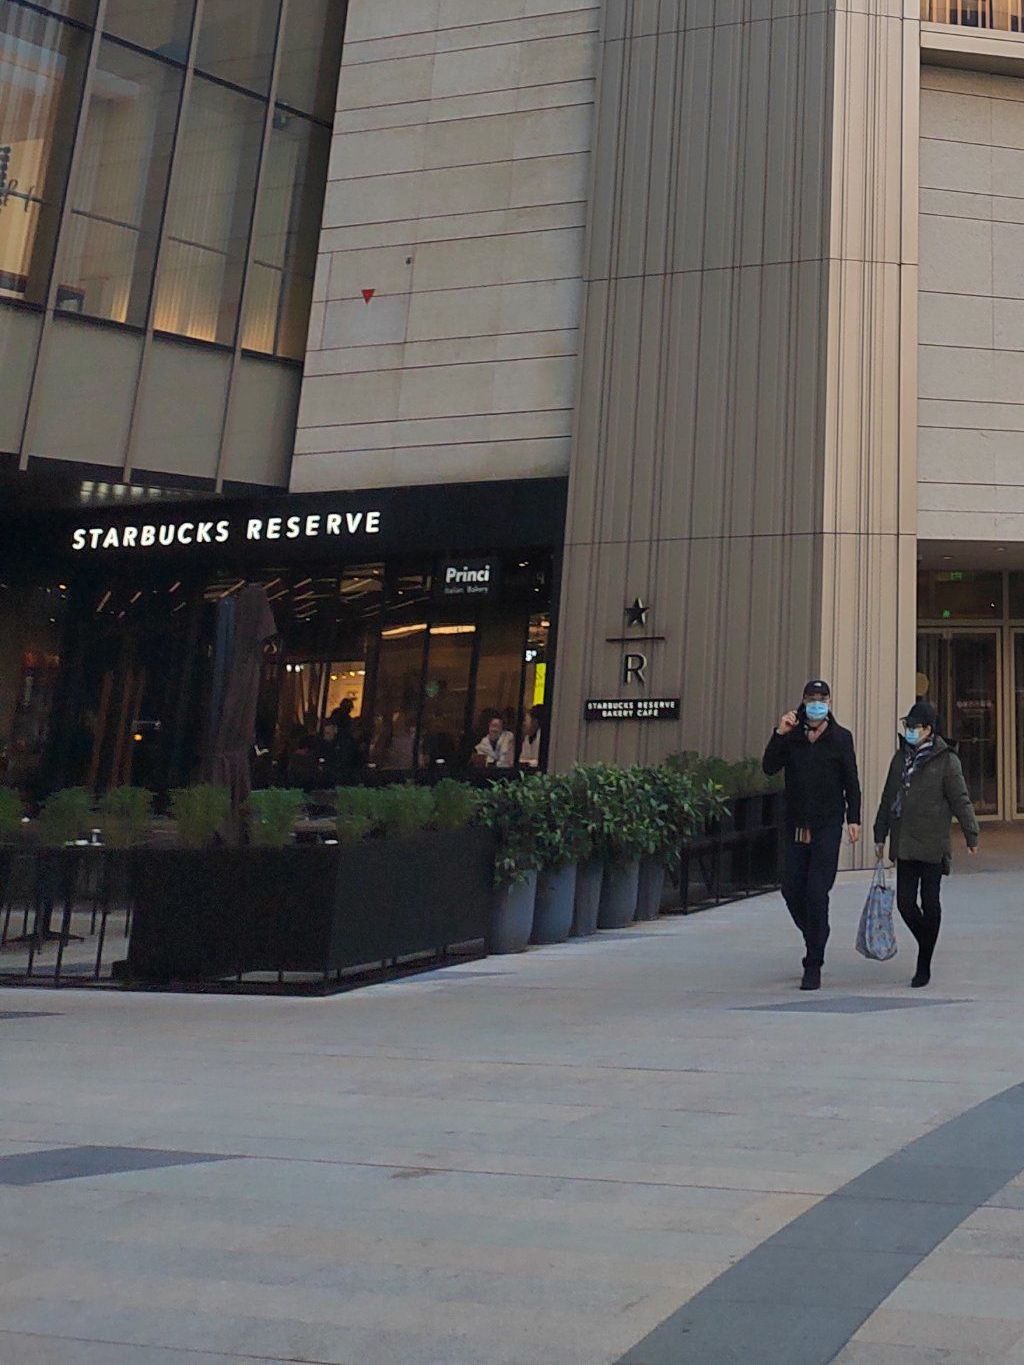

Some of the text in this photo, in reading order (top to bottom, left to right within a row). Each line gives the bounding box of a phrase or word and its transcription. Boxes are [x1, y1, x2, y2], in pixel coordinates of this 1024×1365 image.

[71, 511, 382, 550] STARBUCKS RESERVE
[445, 564, 491, 583] Princi
[622, 652, 648, 687] R
[587, 700, 676, 710] STARBUCKS RESERVE
[601, 709, 634, 718] BAKERY
